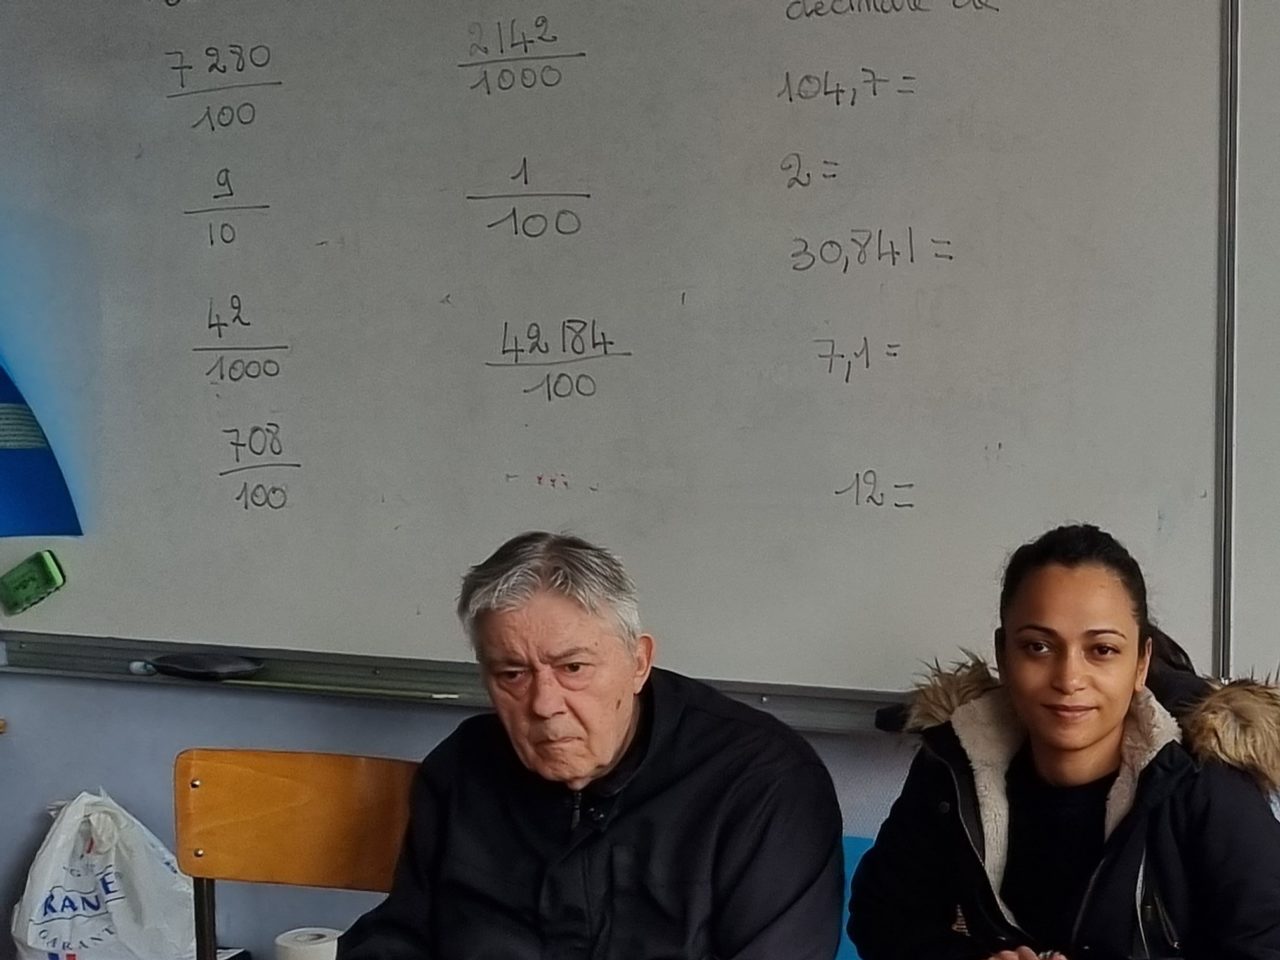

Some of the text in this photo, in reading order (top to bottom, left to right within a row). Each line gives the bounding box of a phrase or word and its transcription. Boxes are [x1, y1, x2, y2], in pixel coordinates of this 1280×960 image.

[467, 64, 562, 96] 1000
[190, 102, 256, 132] 100
[510, 156, 529, 186] 1
[209, 222, 236, 247] 10
[486, 206, 582, 238] 100
[207, 294, 251, 339] 42
[205, 355, 280, 383] 1000
[522, 372, 597, 402] 100
[222, 422, 283, 463] 708
[234, 481, 288, 511] 100
